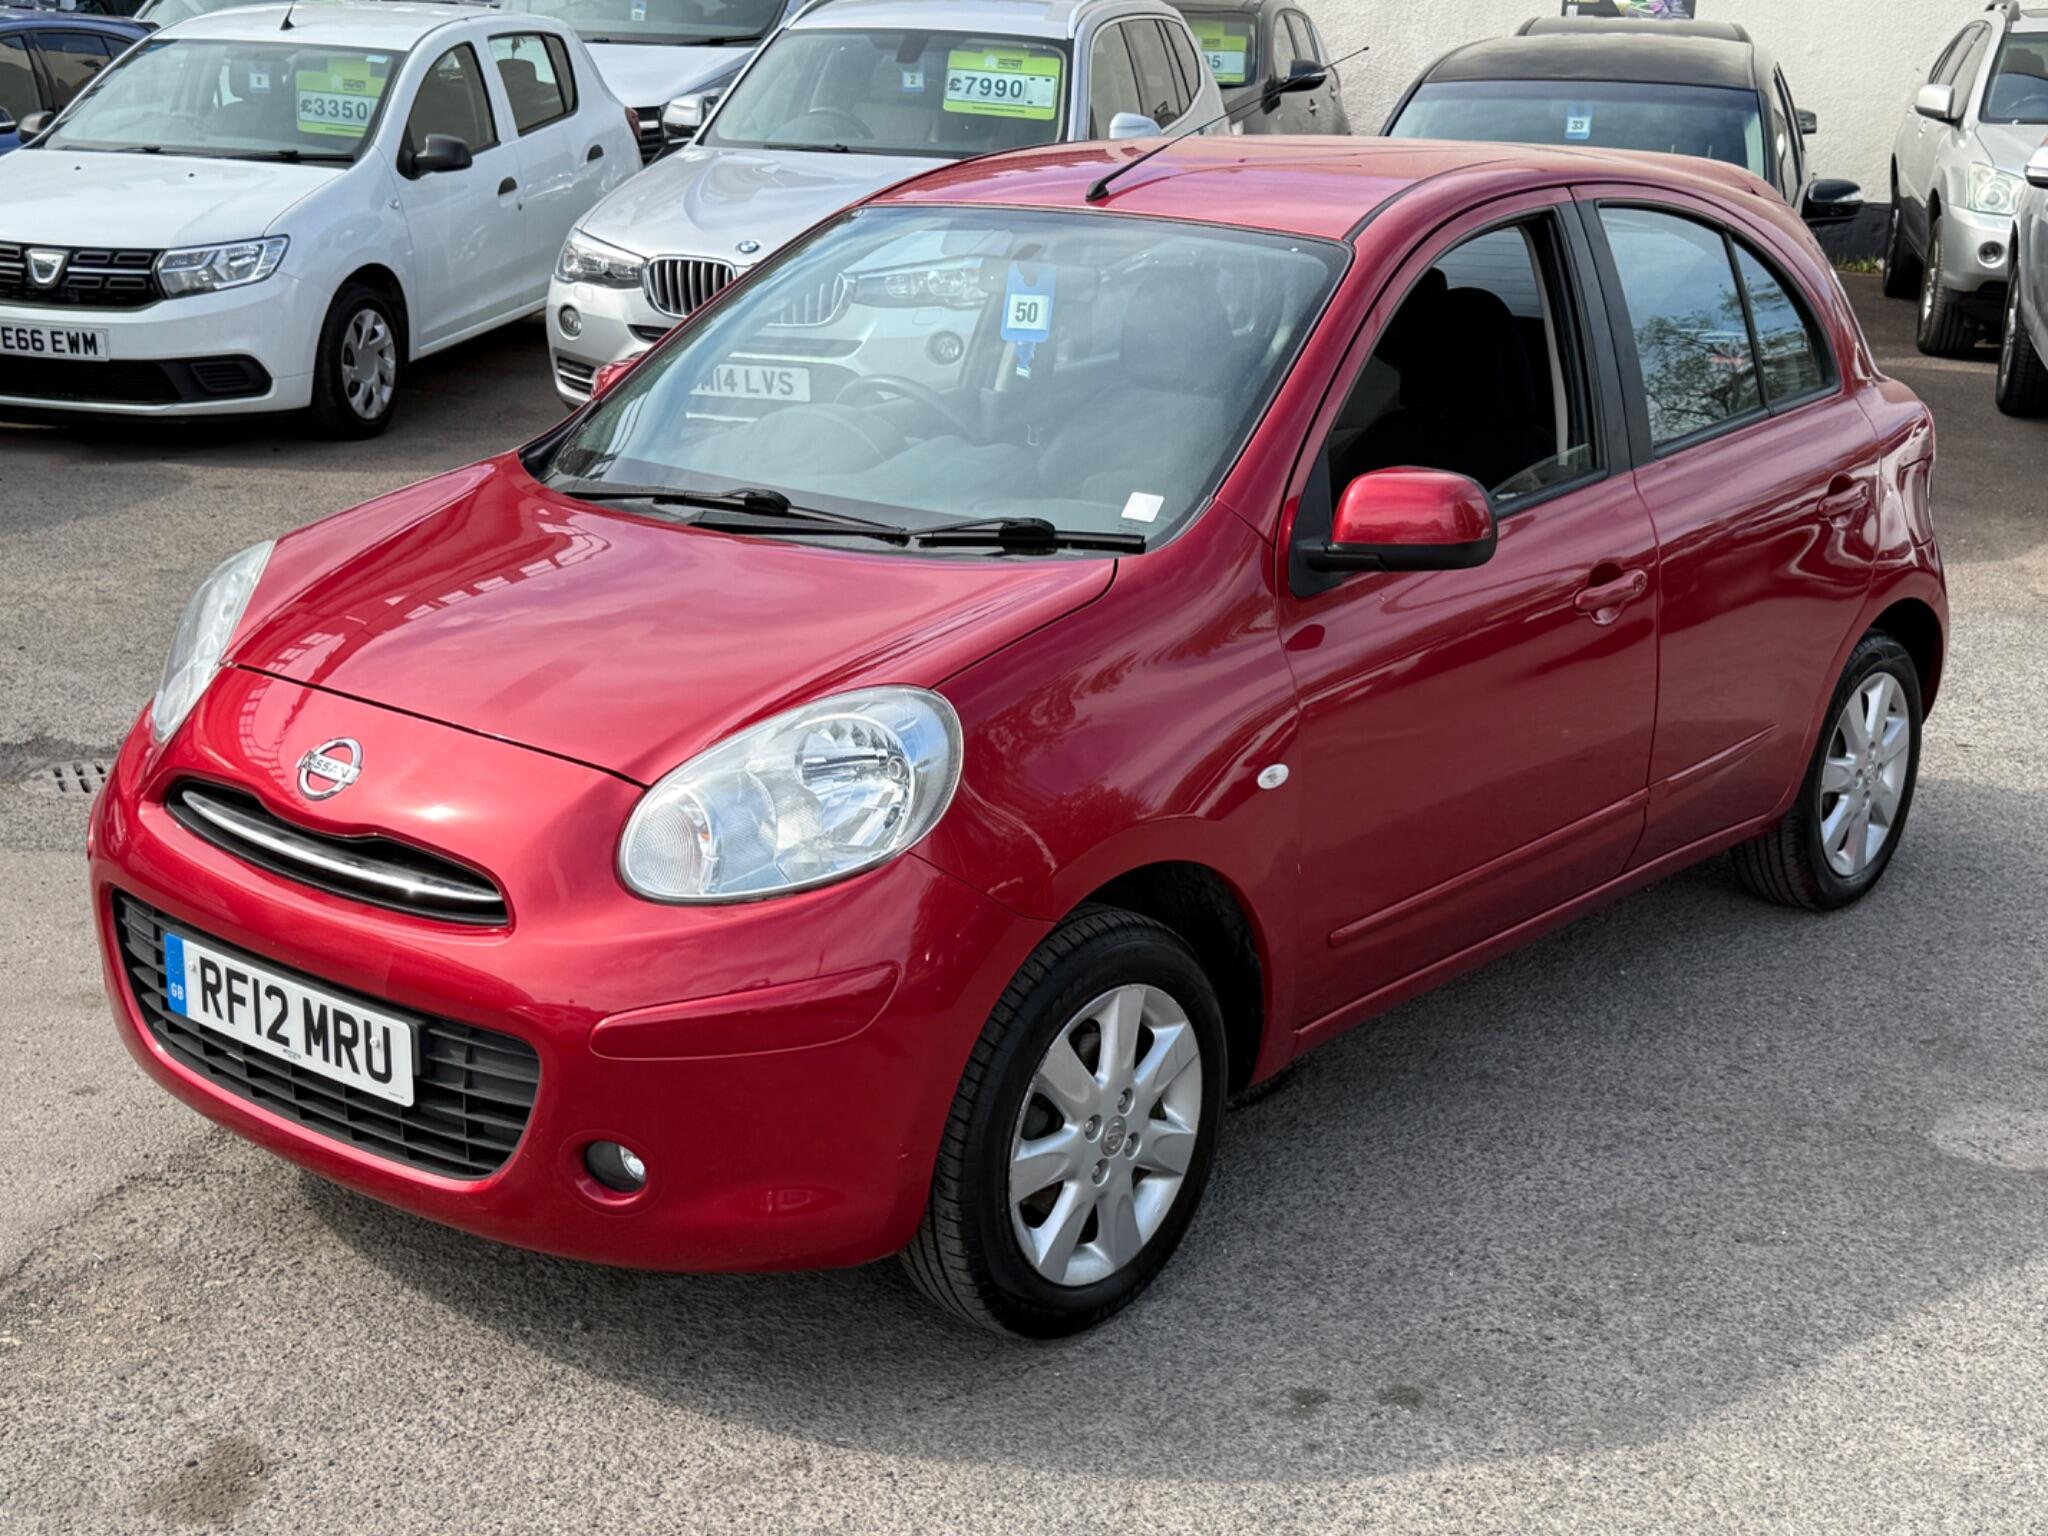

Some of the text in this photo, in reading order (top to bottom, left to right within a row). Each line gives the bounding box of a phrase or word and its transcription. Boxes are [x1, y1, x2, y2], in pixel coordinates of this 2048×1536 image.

[949, 76, 1023, 99] £7990
[301, 98, 368, 121] £3350
[1015, 302, 1038, 323] 50
[0, 326, 98, 355] E66 EWM
[700, 367, 794, 396] M14 LVS
[170, 982, 184, 1001] GB
[199, 955, 393, 1084] RF12 MRU
